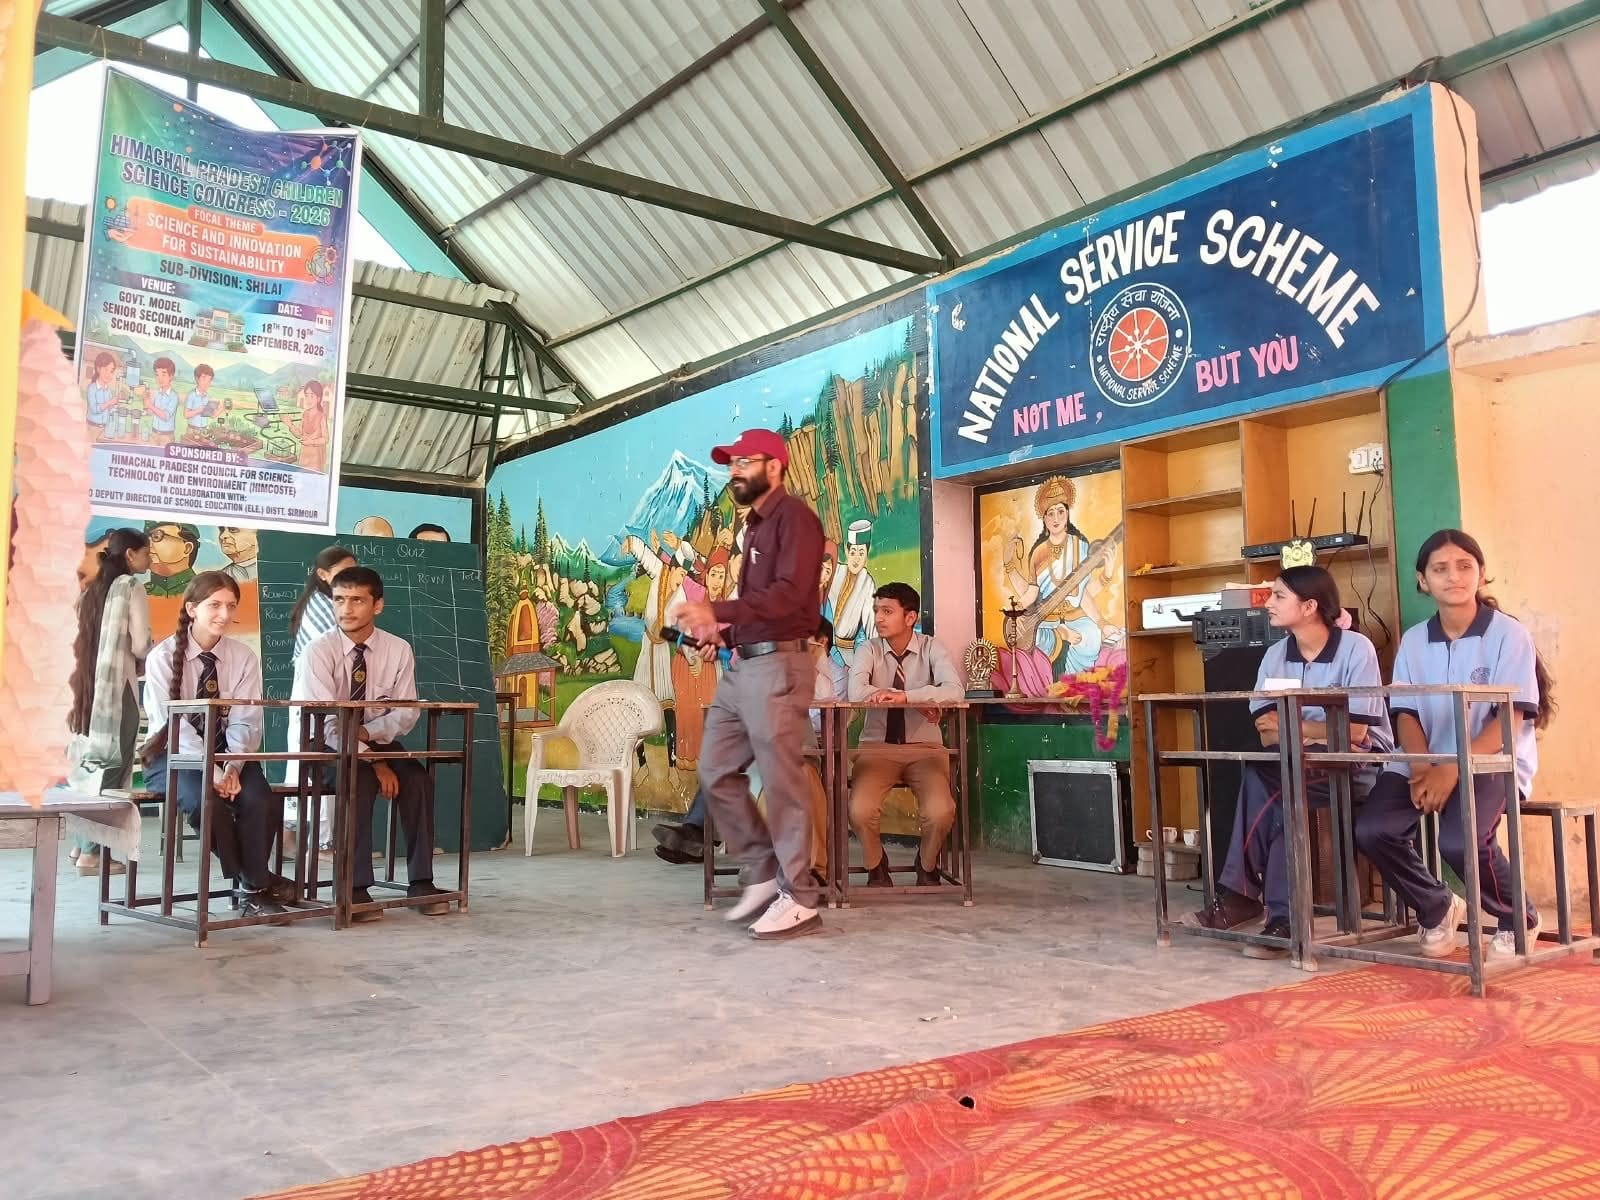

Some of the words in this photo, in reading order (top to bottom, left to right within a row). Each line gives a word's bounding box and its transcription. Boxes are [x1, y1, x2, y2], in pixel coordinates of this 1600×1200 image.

[111, 134, 192, 176] HIMACHAL
[197, 160, 271, 196] PRADESH
[270, 178, 343, 208] CHILDREN
[122, 161, 188, 198] SCIENCE
[193, 185, 275, 218] CONGRESS
[290, 204, 331, 226] 2026
[146, 212, 199, 238] SCIENCE
[202, 229, 225, 246] AND
[229, 234, 301, 258] INNOVATION
[194, 209, 223, 228] FOCAL
[225, 216, 256, 233] THEME
[162, 236, 186, 253] FOR
[191, 242, 285, 273] SUSTAINABILITY
[140, 277, 176, 294] VENUE:
[160, 259, 242, 290] SUB-DIVISION:
[246, 279, 282, 295] SHILAI
[102, 301, 137, 318] SENIOR
[139, 308, 196, 329] SECONDARY
[118, 290, 146, 306] GOVT.
[149, 297, 182, 313] MODEL
[277, 302, 303, 317] DATE:
[1120, 290, 1148, 307] सेवा
[1150, 288, 1181, 321] योजना
[111, 317, 150, 336] SCHOOL,
[153, 328, 184, 341] SHILAI
[262, 322, 280, 333] 18TH
[282, 325, 294, 337] TO
[296, 327, 313, 339] 19TH
[958, 293, 1060, 444] NATIONAL
[1060, 210, 1186, 305] SERVICE
[1200, 208, 1381, 349] SCHEME
[303, 342, 324, 356] 2026
[1098, 364, 1126, 398] NATIONAL
[1159, 344, 1183, 384] SCHEME
[1013, 400, 1051, 437] NOT
[1195, 350, 1241, 393] BUT
[1248, 335, 1299, 378] YOU
[111, 453, 157, 469] HIMACHAL
[160, 460, 199, 474] PRADESH
[201, 464, 238, 478] COUNCIL
[240, 470, 256, 480] FOR
[169, 445, 223, 462] SPONSORED
[108, 466, 164, 483] TECHNOLOGY
[167, 473, 185, 486] AND
[187, 475, 246, 491] ENVIRONMENT
[249, 481, 297, 497] (HIMCOSTE)
[160, 485, 168, 494] IN
[169, 486, 225, 501] COLLABORATION
[227, 493, 247, 502] WITH:
[95, 489, 124, 501] DEPUTY
[126, 492, 161, 504] DIRECTOR
[164, 496, 174, 505] OF
[175, 497, 203, 508] SCHOOL
[205, 500, 243, 512] EDUCATION
[288, 507, 319, 518] SIRMOUR
